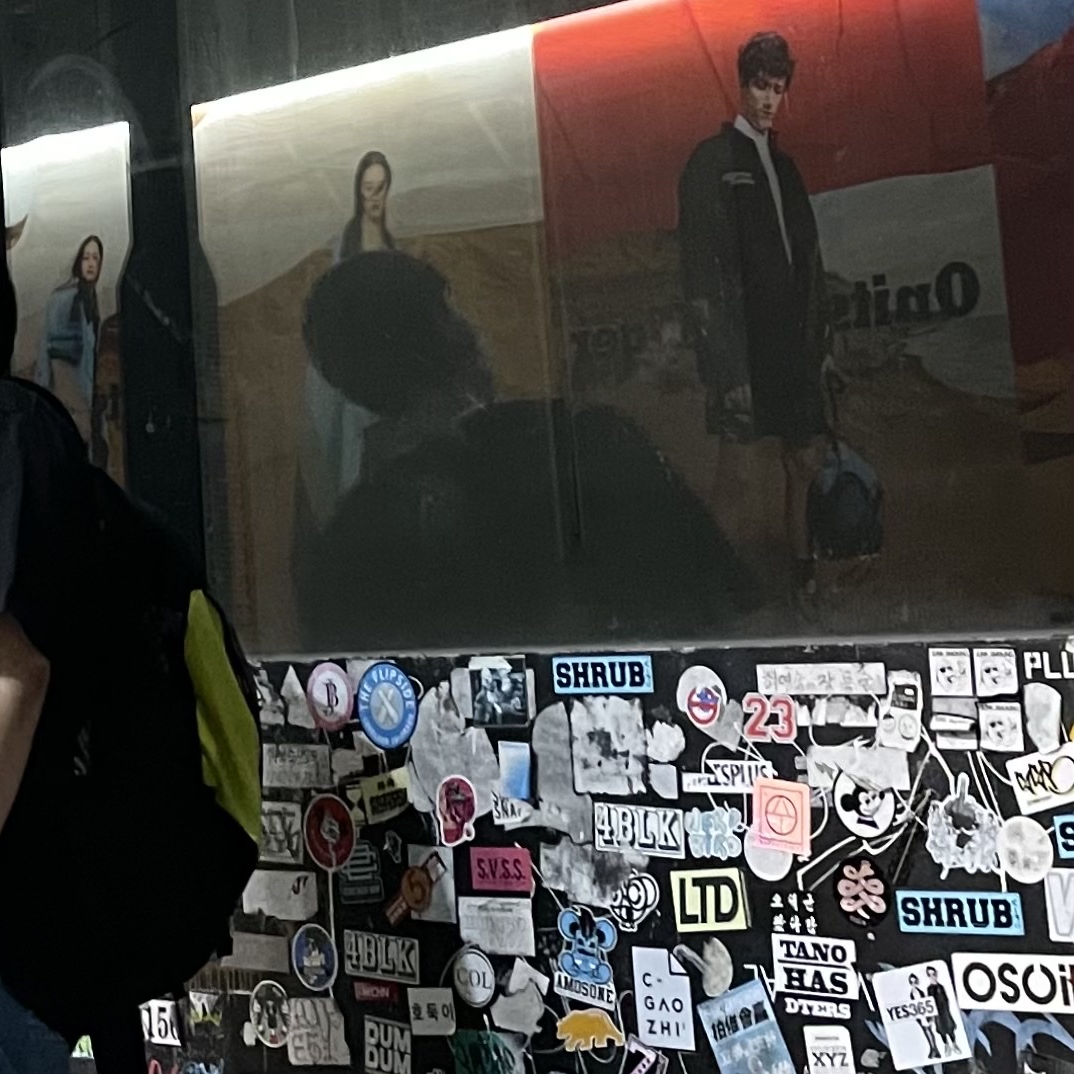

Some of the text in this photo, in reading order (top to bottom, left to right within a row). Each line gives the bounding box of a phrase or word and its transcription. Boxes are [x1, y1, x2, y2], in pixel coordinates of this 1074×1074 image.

[556, 661, 645, 688] SHRUB
[743, 695, 795, 740] 23
[596, 804, 682, 850] 4BLK
[679, 876, 739, 925] LTD
[901, 897, 1014, 929] SHRUB
[345, 931, 417, 977] 4BLK
[779, 939, 847, 963] TANO
[783, 966, 849, 995] HAS
[886, 1000, 934, 1021] YES365
[812, 1051, 849, 1067] XYZ
